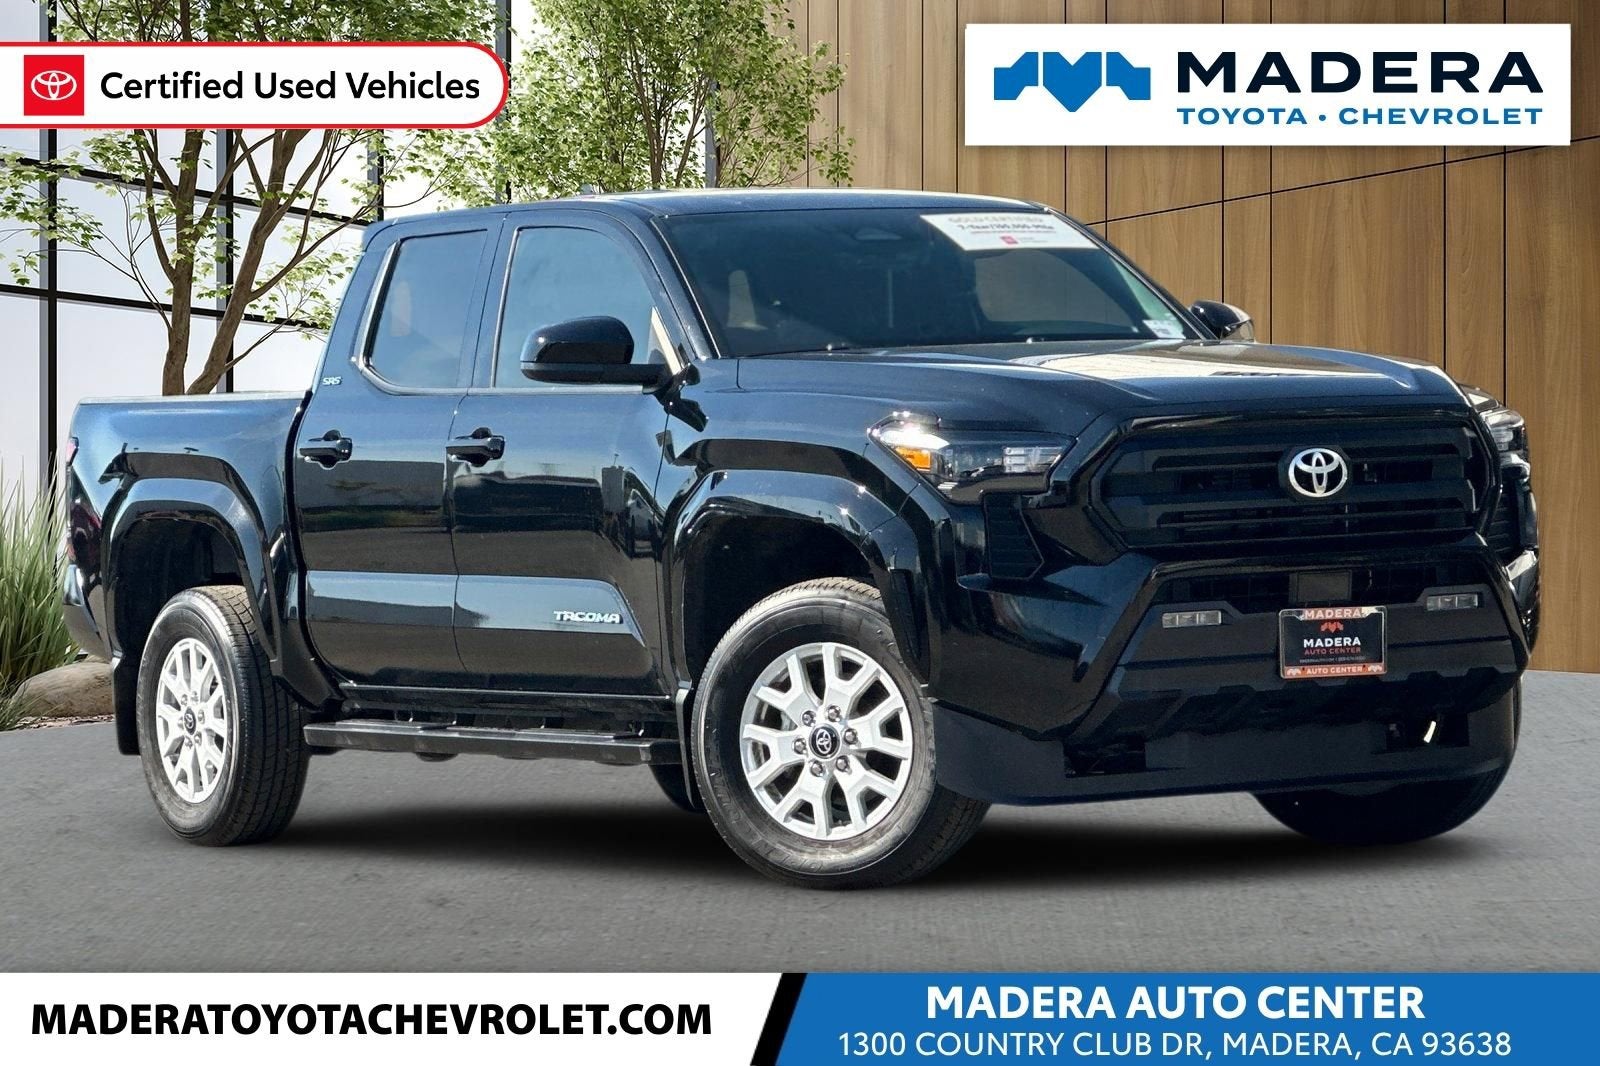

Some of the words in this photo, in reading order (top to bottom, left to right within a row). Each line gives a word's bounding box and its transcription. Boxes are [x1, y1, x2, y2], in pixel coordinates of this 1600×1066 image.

[553, 610, 621, 625] TACOMA
[1304, 608, 1361, 620] MADERA
[1303, 636, 1361, 648] MADERA
[1304, 648, 1327, 656] AUTO
[1328, 646, 1361, 655] CENTER
[1306, 667, 1329, 675] AUTO
[1330, 665, 1363, 674] CENTER
